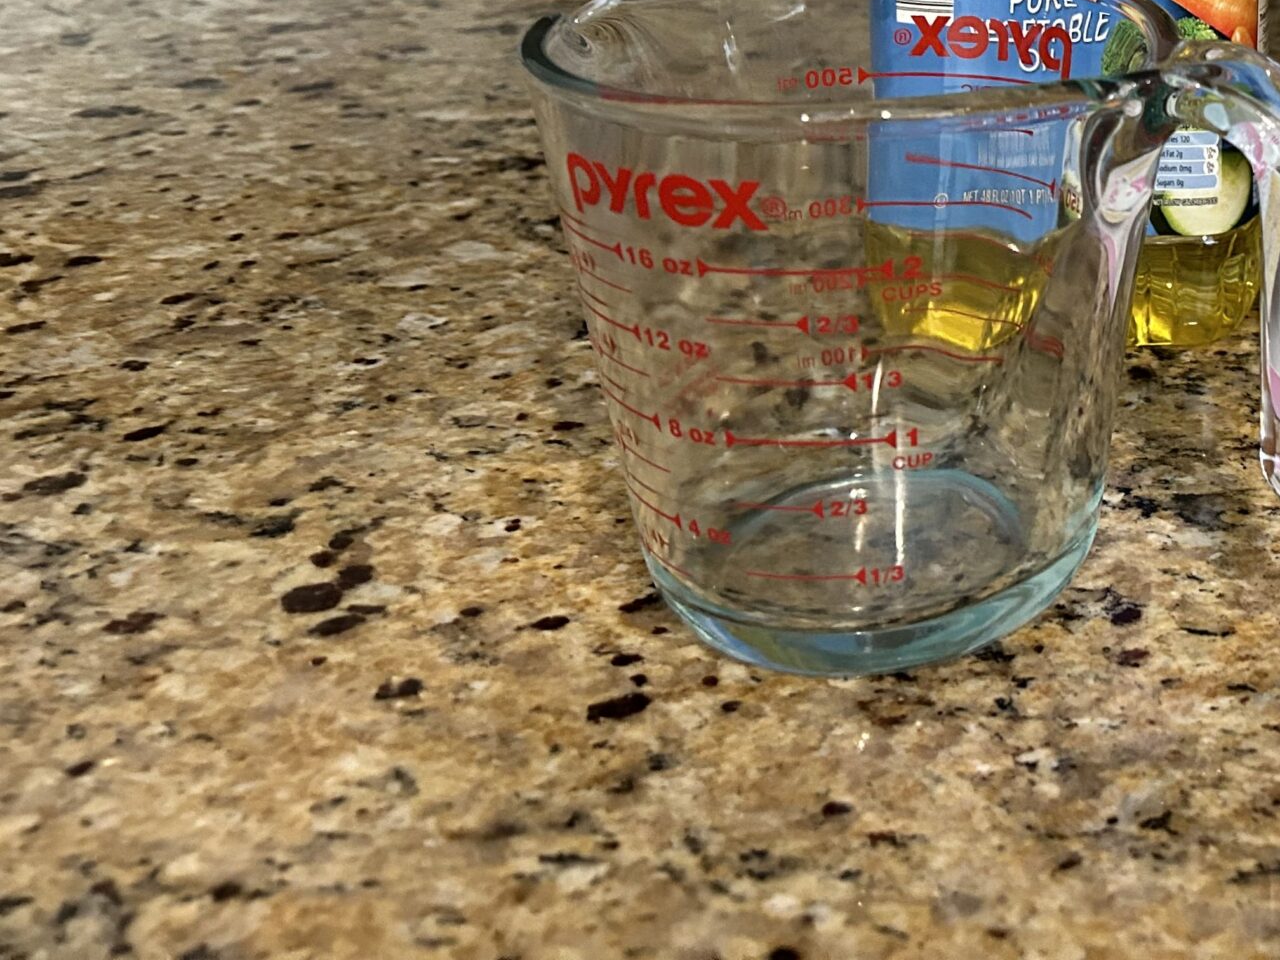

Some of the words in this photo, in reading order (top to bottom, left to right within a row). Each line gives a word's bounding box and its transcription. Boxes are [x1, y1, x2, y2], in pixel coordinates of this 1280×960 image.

[566, 152, 769, 231] pyrex
[625, 246, 654, 270] 16
[903, 255, 924, 278] 2
[882, 282, 943, 302] CUPS
[816, 315, 859, 334] 2/3
[644, 326, 671, 350] 12
[863, 371, 902, 390] 13
[669, 418, 682, 438] 8
[906, 427, 918, 447] 1
[892, 452, 933, 471] CUP
[830, 500, 868, 517] 2/3
[871, 565, 904, 583] 1/3
